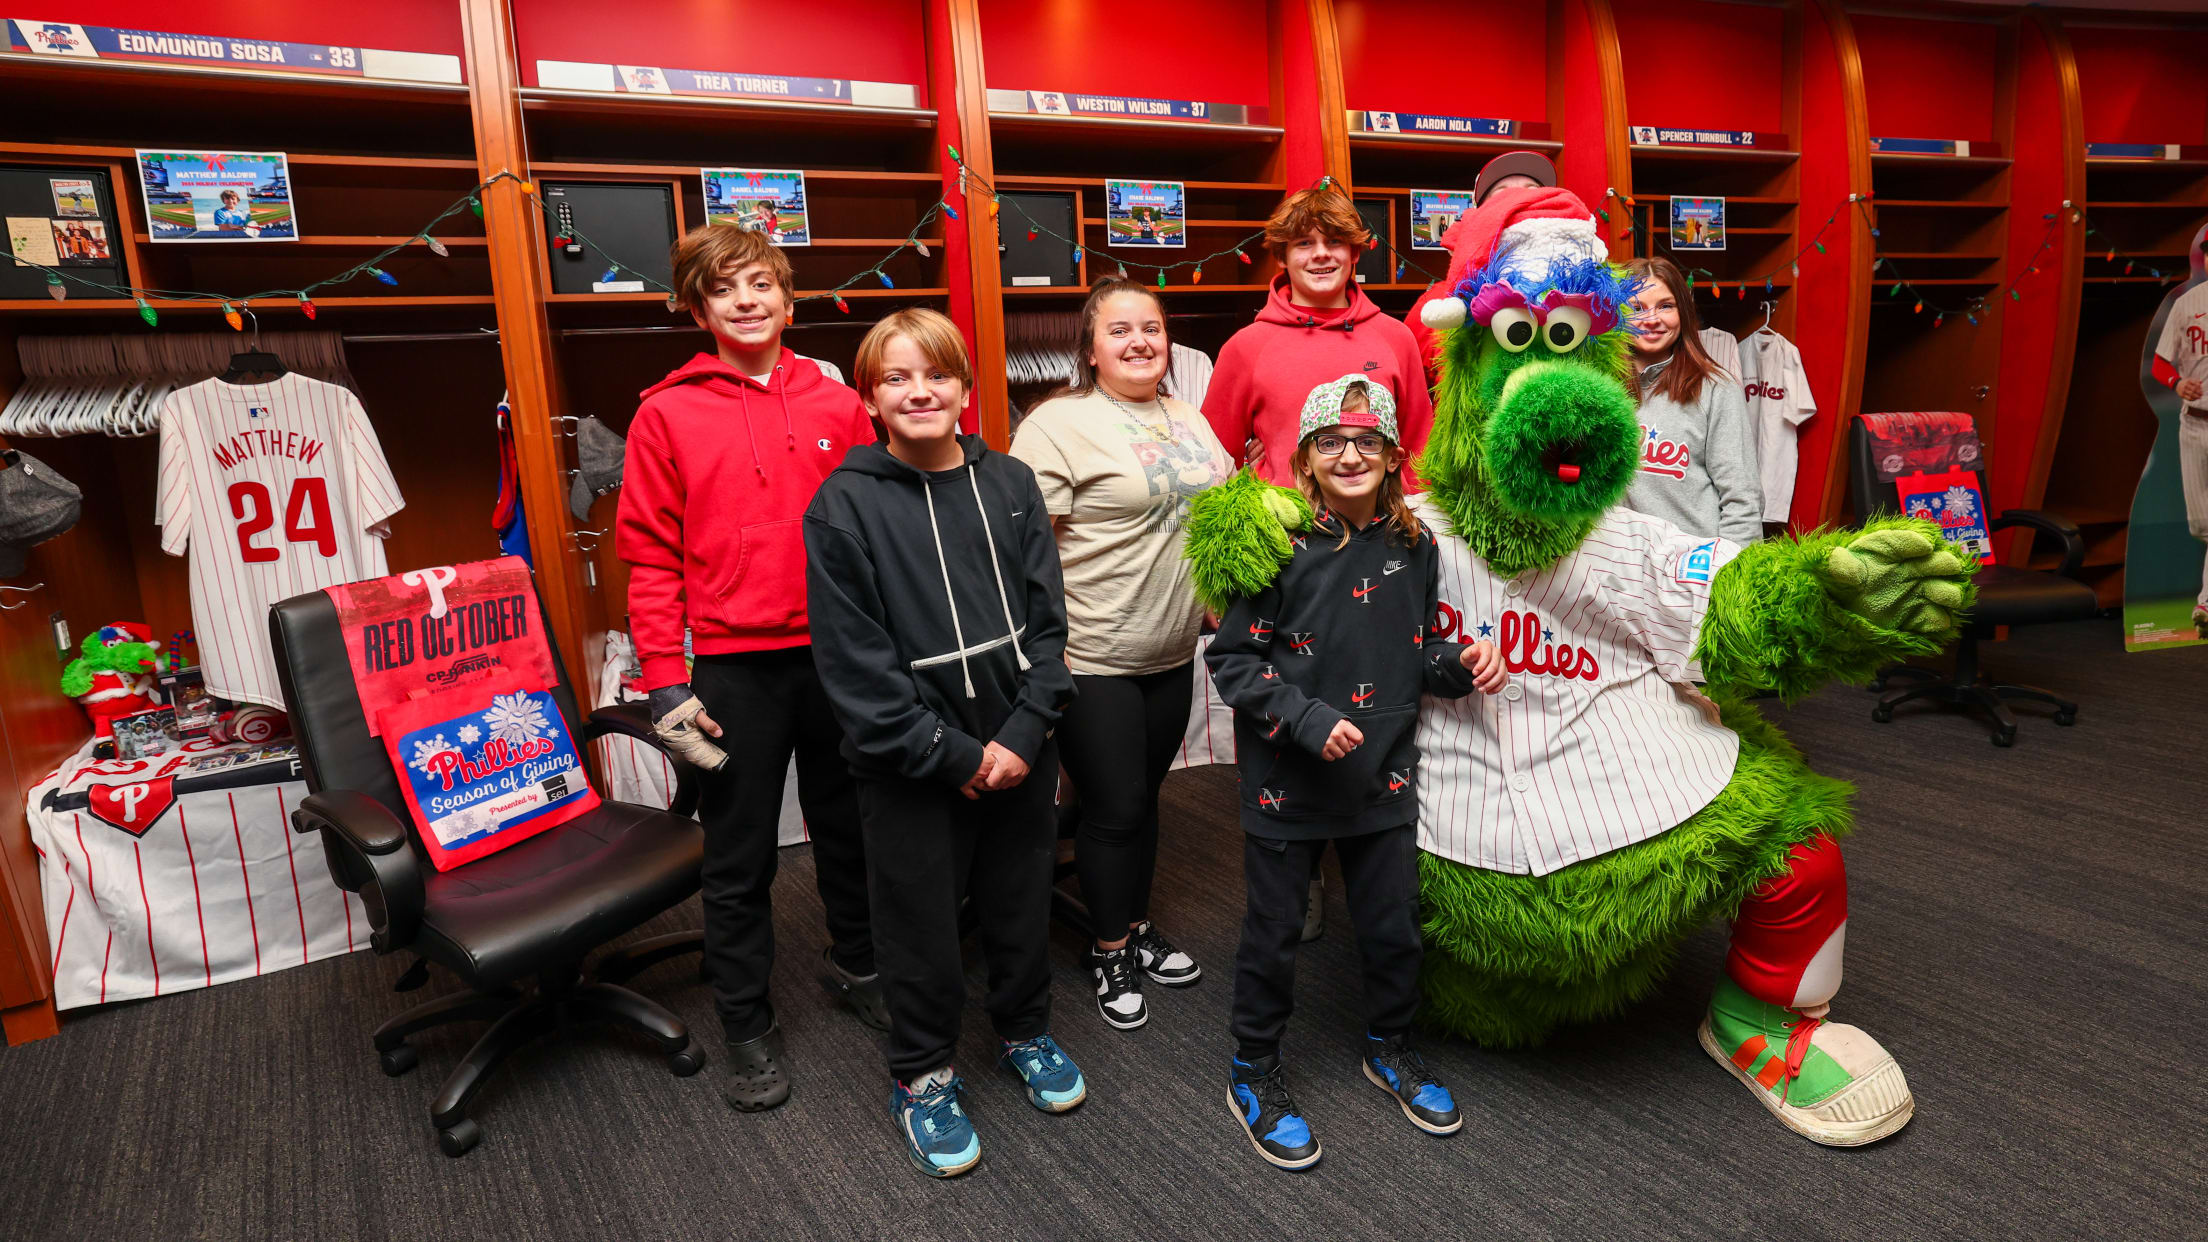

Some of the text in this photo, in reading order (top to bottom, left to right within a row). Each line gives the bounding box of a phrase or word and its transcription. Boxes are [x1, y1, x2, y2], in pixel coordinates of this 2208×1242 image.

[35, 31, 79, 46] Phillies
[118, 33, 357, 68] EDMUNDO SOSA 33
[693, 74, 731, 91] TREA
[734, 77, 788, 94] TURNER
[833, 80, 841, 97] 7
[1076, 98, 1126, 112] WESTON
[1128, 101, 1171, 115] WILSON
[1191, 102, 1205, 117] 37
[1415, 118, 1510, 134] AARON NOLA 27
[1660, 131, 1752, 144] SPENCER TURNBULL 22
[213, 430, 324, 470] MATTHEW
[228, 477, 338, 563] 24
[363, 594, 528, 675] RED OCTOBER
[427, 737, 555, 791] Phillies
[431, 753, 575, 814] Season of Giving
[489, 793, 538, 816] Presented by
